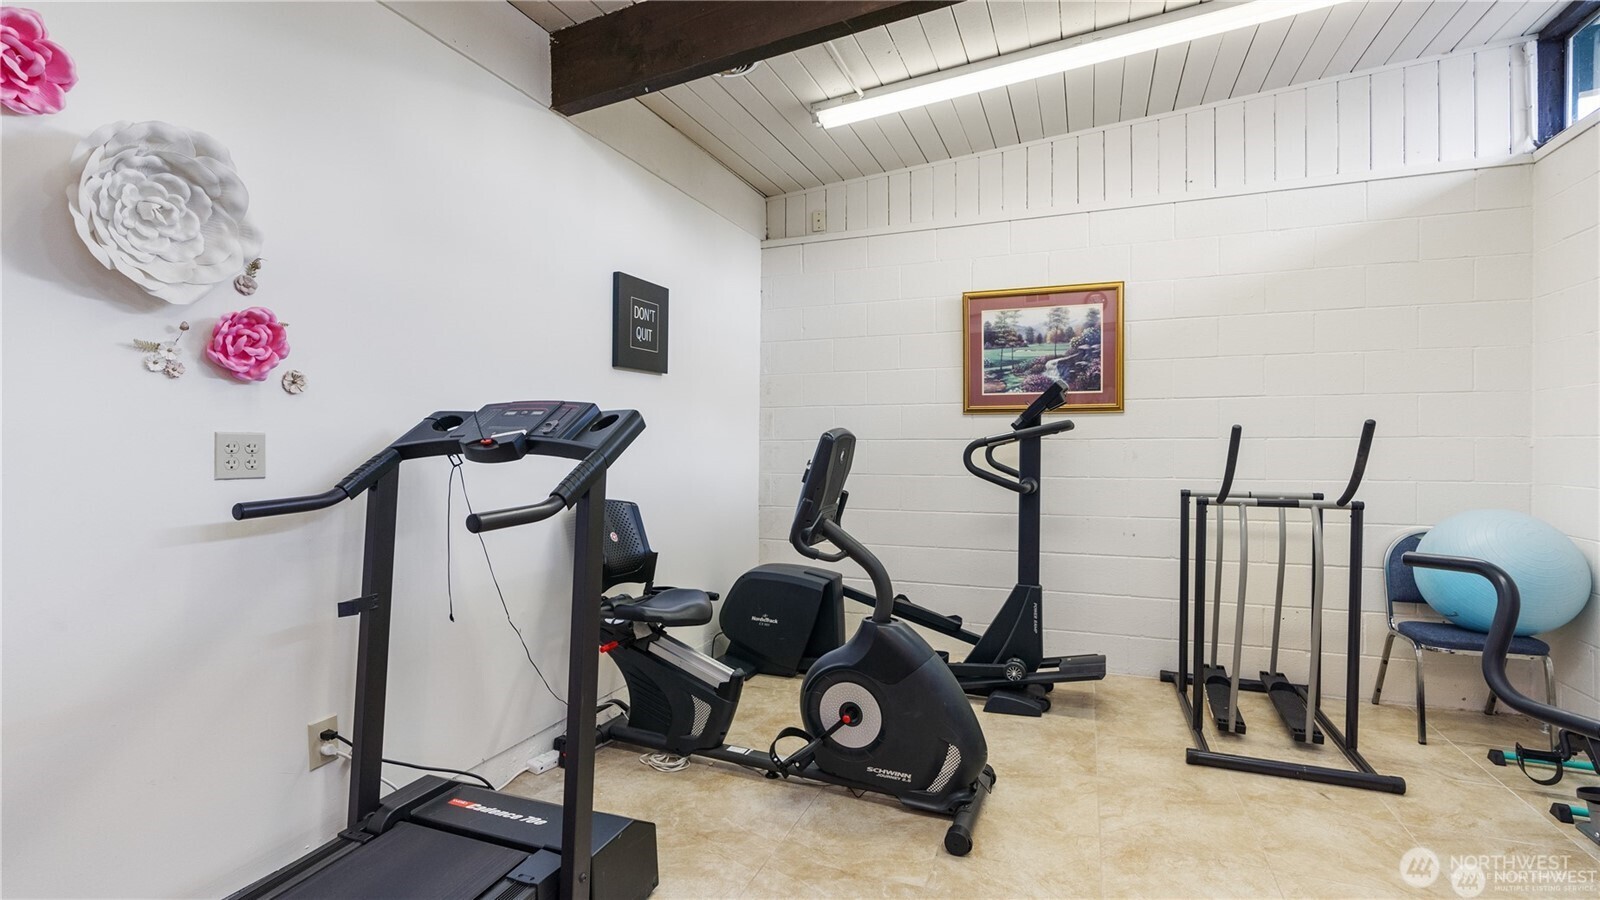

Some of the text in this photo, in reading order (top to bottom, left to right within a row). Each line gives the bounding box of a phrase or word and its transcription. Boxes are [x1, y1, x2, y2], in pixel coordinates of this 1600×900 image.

[633, 305, 656, 323] DON'T
[635, 326, 653, 342] QUIT
[751, 615, 778, 624] NordicTrack
[866, 766, 912, 779] SCHWINN
[465, 803, 524, 820] Cadence
